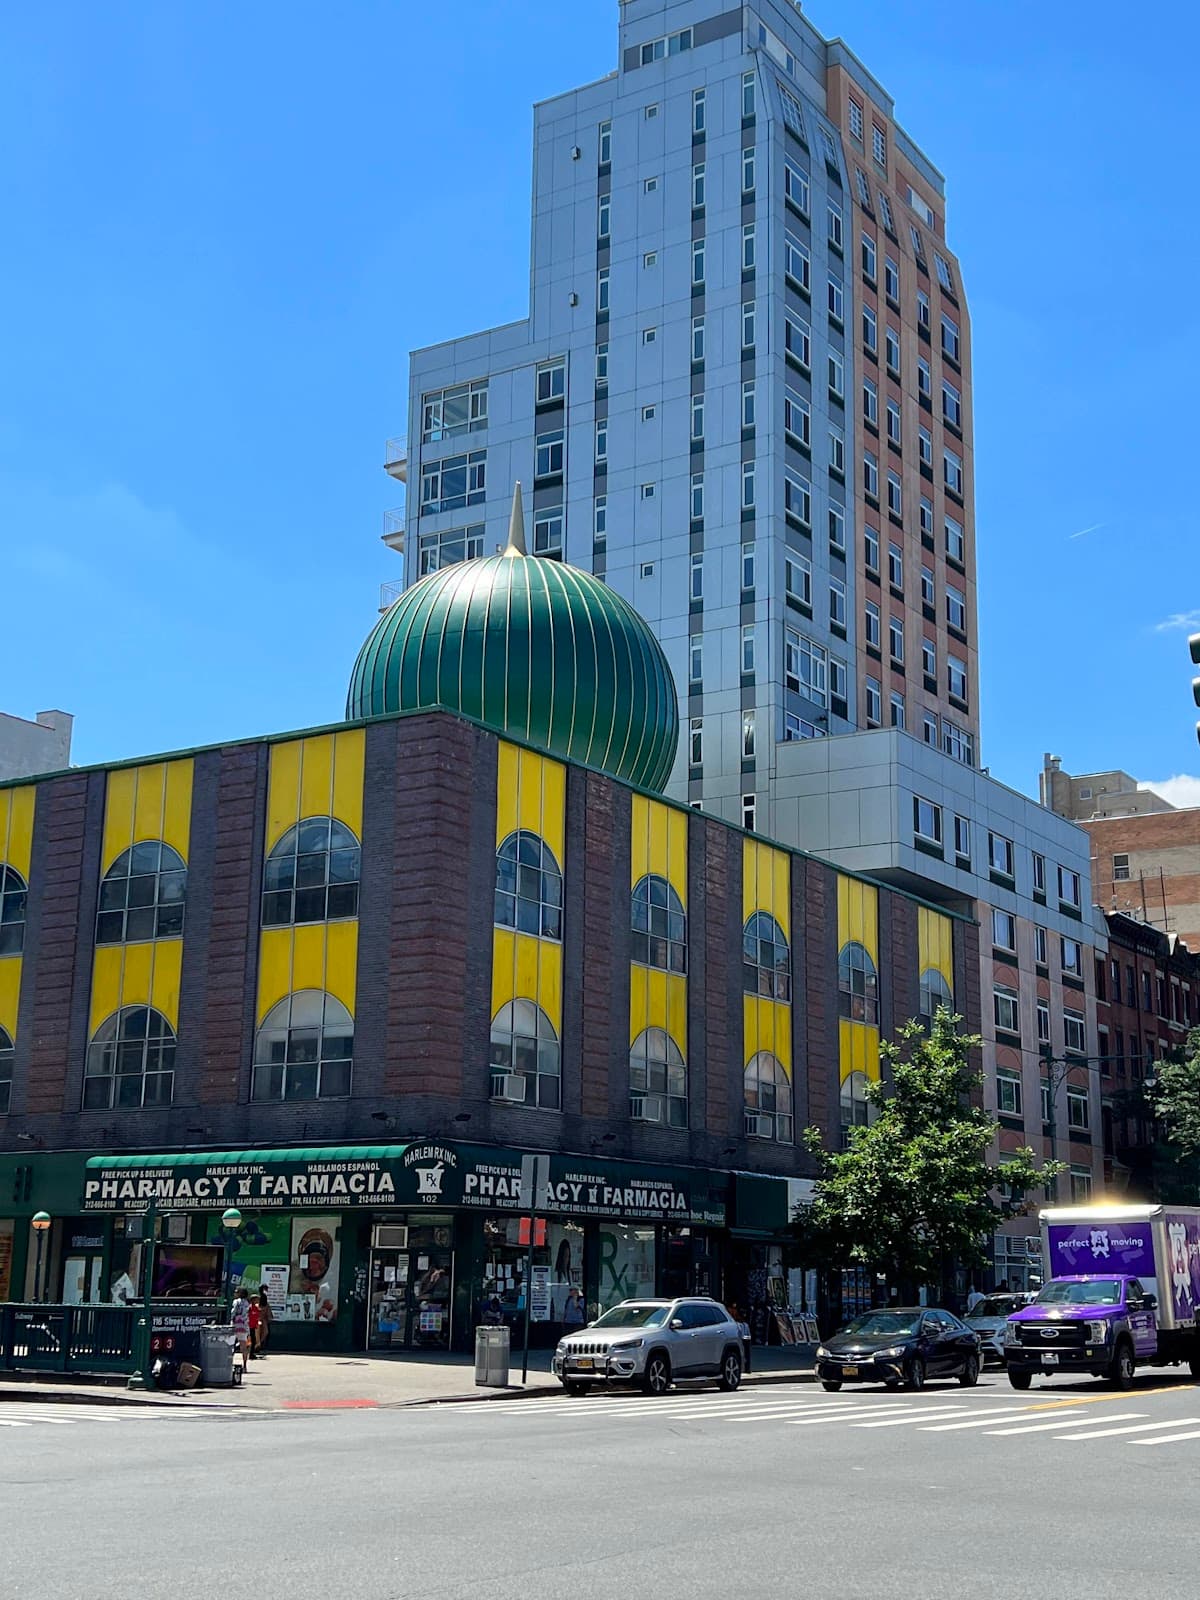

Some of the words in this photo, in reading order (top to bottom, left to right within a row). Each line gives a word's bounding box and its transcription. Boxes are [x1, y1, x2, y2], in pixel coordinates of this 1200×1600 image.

[404, 1146, 433, 1167] HARLEM
[434, 1146, 444, 1159] RX
[444, 1149, 458, 1168] INC.
[206, 1166, 238, 1176] HARLEM
[239, 1166, 248, 1175] RX
[249, 1165, 266, 1175] INC.
[307, 1163, 346, 1173] HABLAMOS
[347, 1161, 380, 1171] ESPAÑOL
[475, 1164, 488, 1174] FREE
[489, 1166, 500, 1175] PICK
[101, 1170, 116, 1179] FREE
[116, 1170, 130, 1178] PICK
[130, 1170, 139, 1178] UP
[145, 1169, 174, 1178] DELIVERY
[565, 1172, 587, 1183] HARLEM
[85, 1177, 230, 1198] PHARMACY
[260, 1172, 395, 1195] FARMACIA
[465, 1174, 582, 1202] PHARACY
[421, 1195, 438, 1203] 102
[603, 1186, 687, 1209] FARMACIA
[703, 1210, 725, 1222] Repair
[1058, 1239, 1090, 1249] perfect
[1110, 1237, 1144, 1247] moving
[153, 1317, 163, 1326] 116
[164, 1316, 184, 1326] Street
[184, 1316, 207, 1325] Station
[153, 1339, 160, 1349] 2
[166, 1339, 173, 1349] 3
